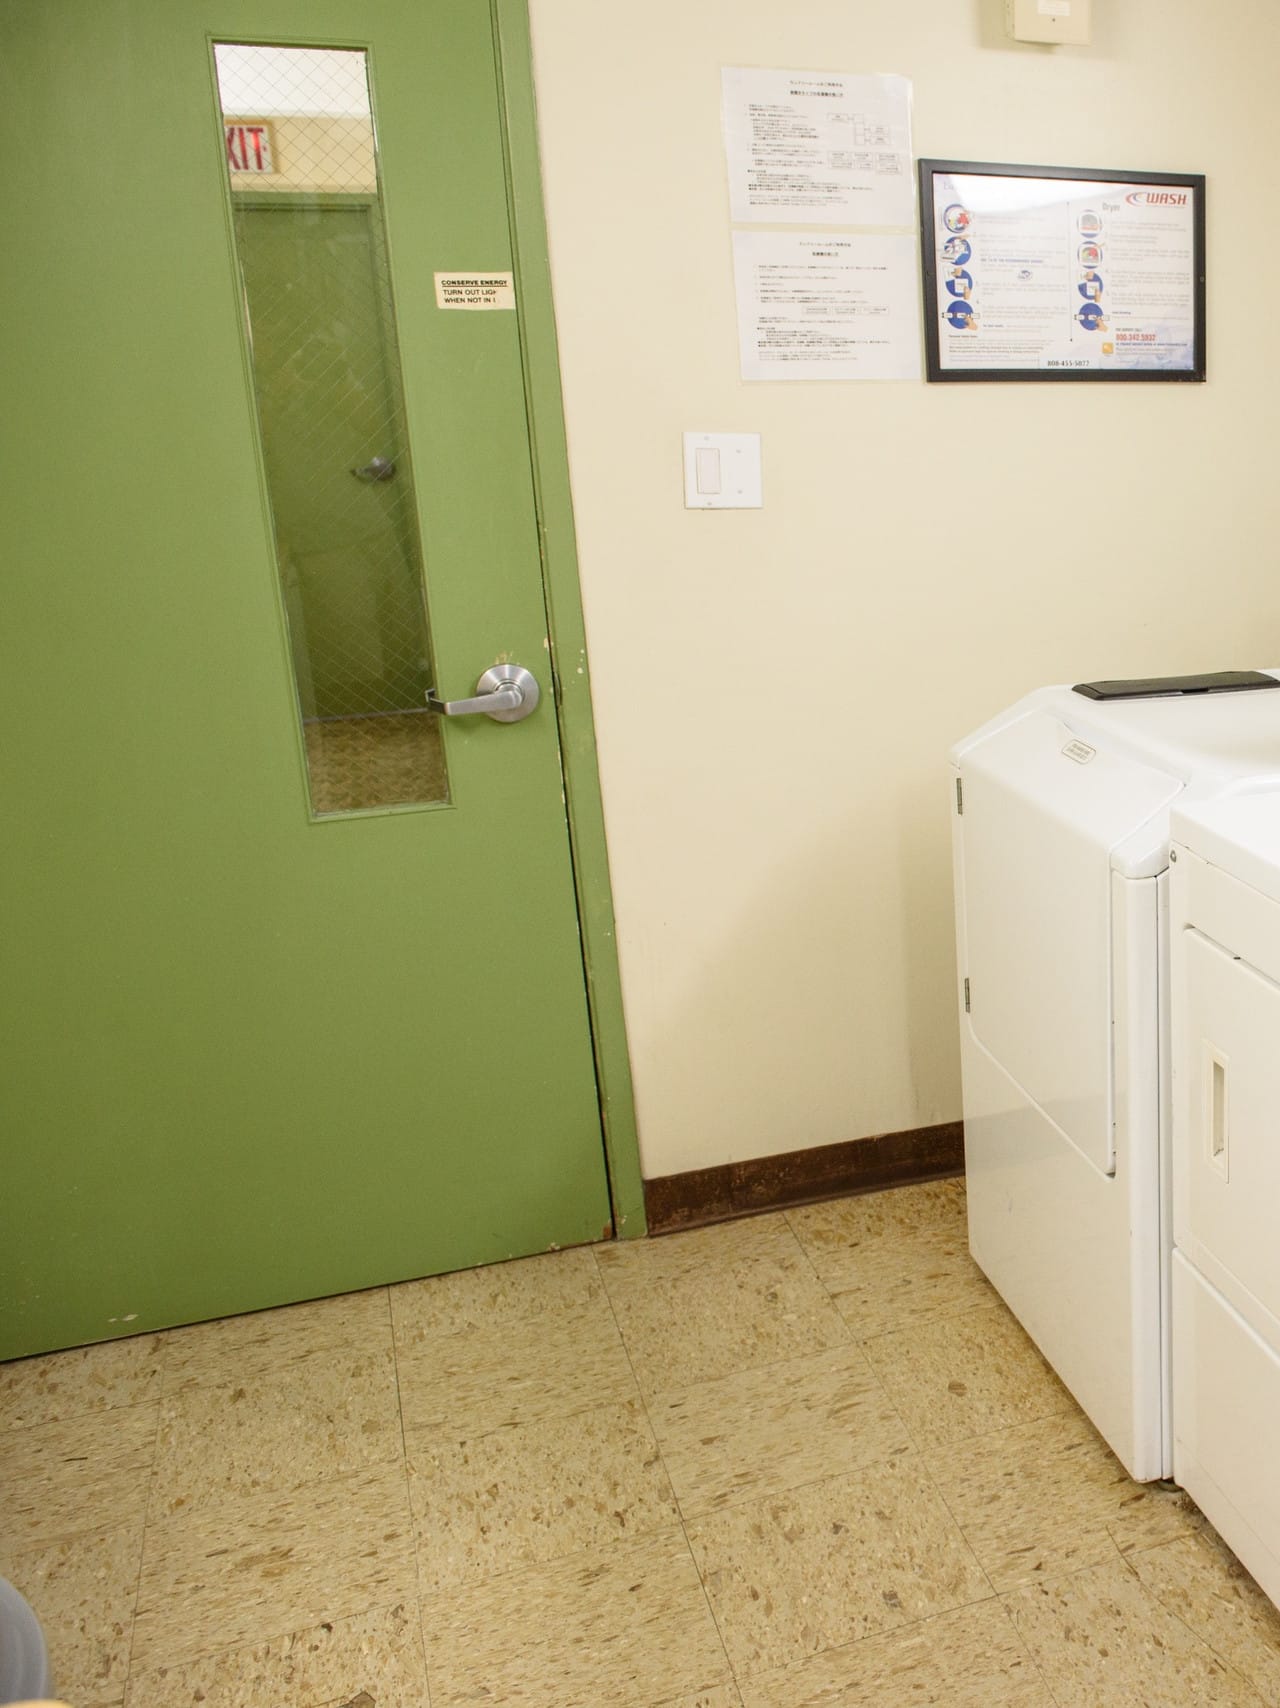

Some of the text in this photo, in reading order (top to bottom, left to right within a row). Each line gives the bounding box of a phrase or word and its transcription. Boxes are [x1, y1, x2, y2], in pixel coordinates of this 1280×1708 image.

[227, 127, 264, 170] XIT
[1146, 192, 1187, 205] WASH
[1102, 203, 1120, 212] Dryer
